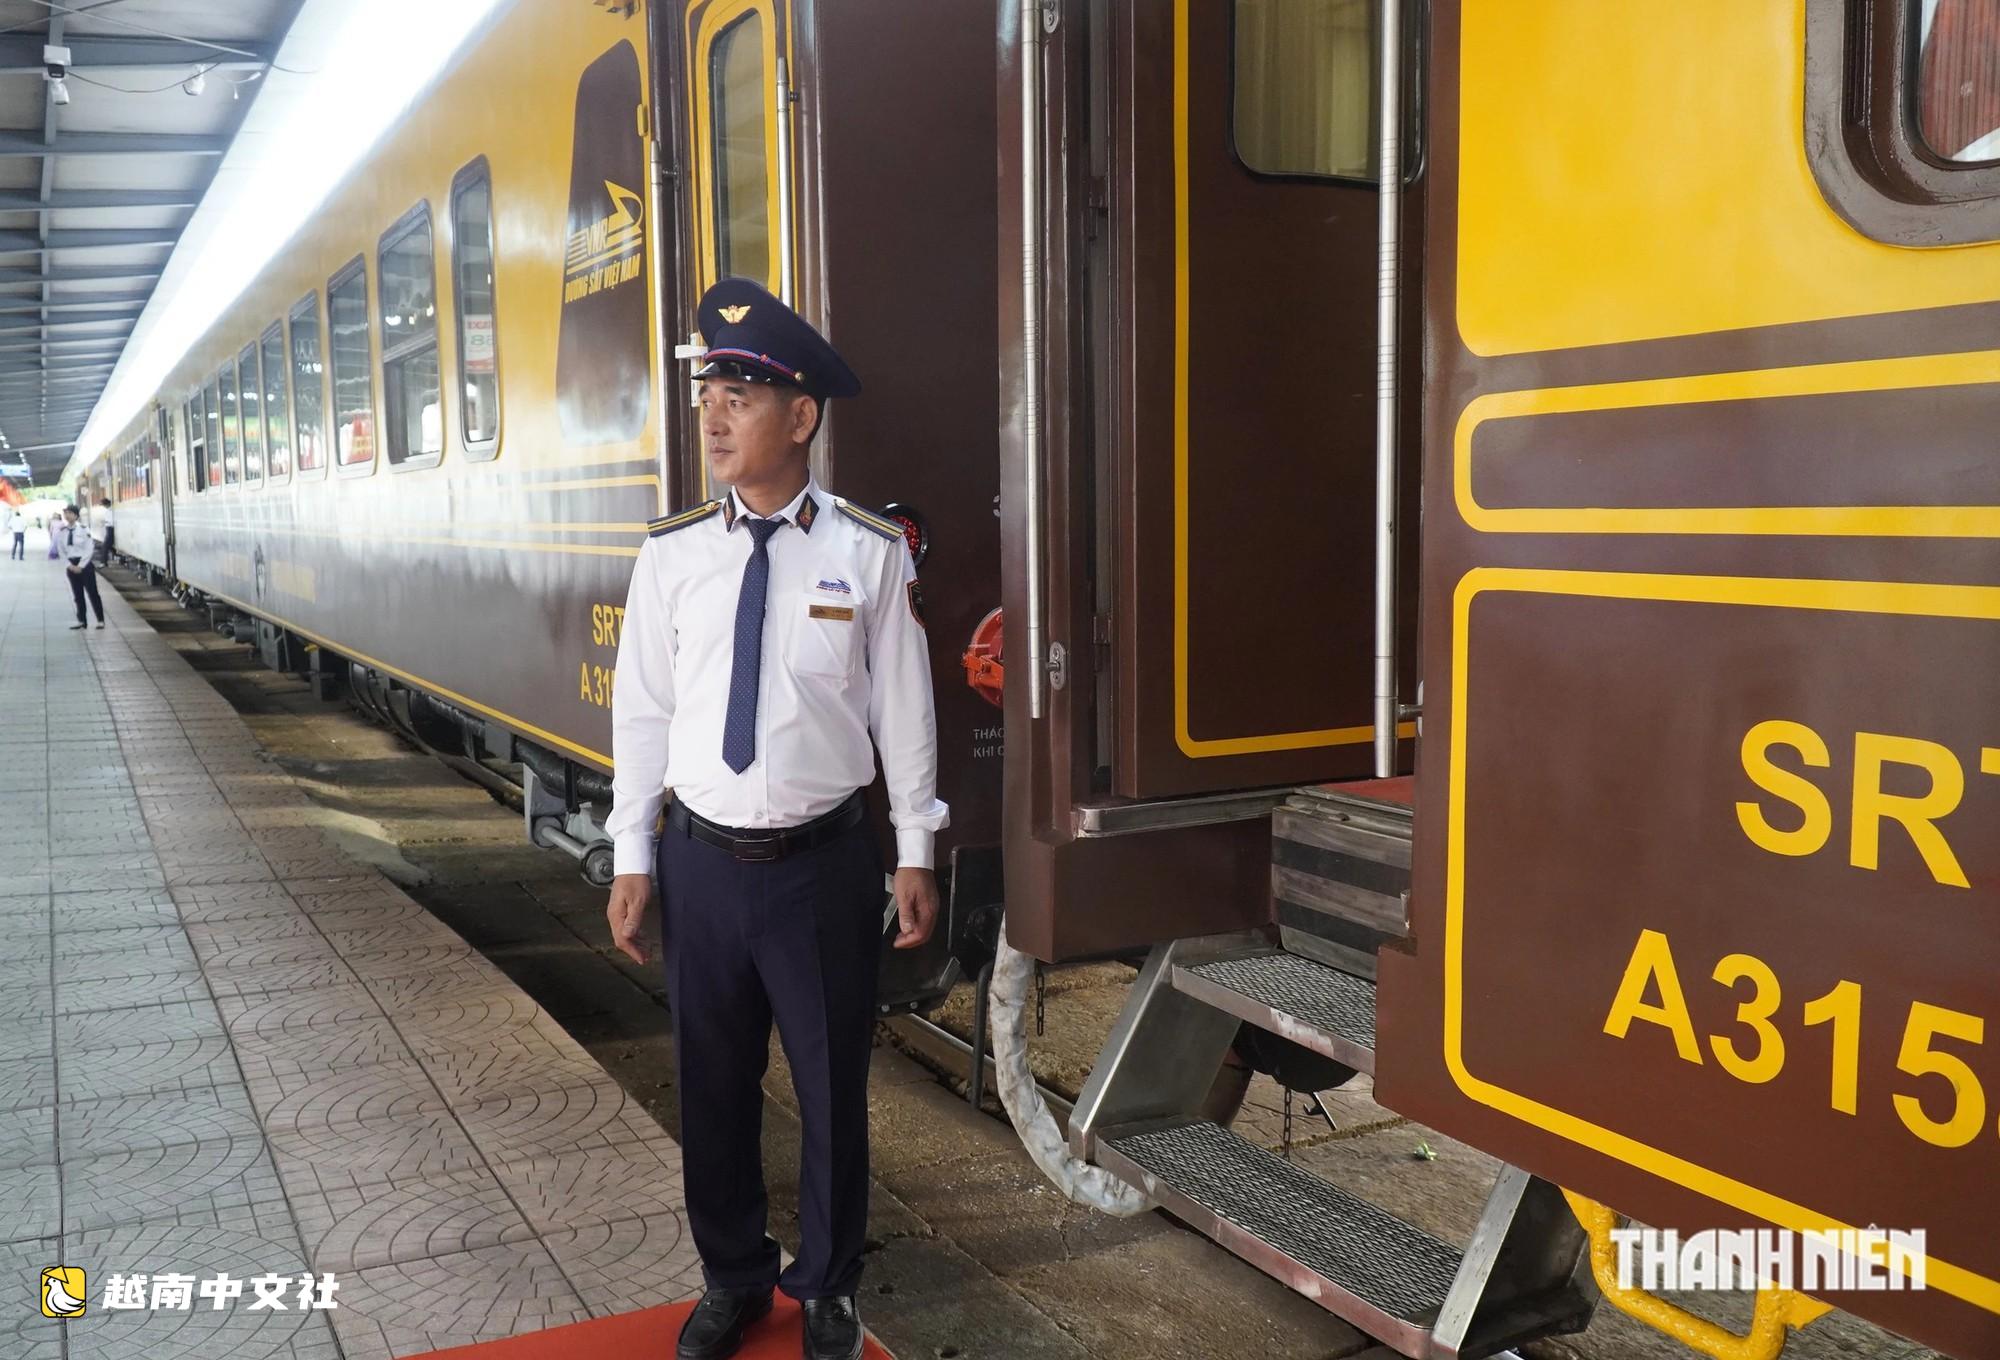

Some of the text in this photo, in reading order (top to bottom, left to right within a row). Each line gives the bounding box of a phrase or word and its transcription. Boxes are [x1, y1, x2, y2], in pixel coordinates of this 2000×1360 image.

[585, 218, 608, 257] VNR
[620, 253, 641, 283] NAM
[973, 746, 994, 759] KHI
